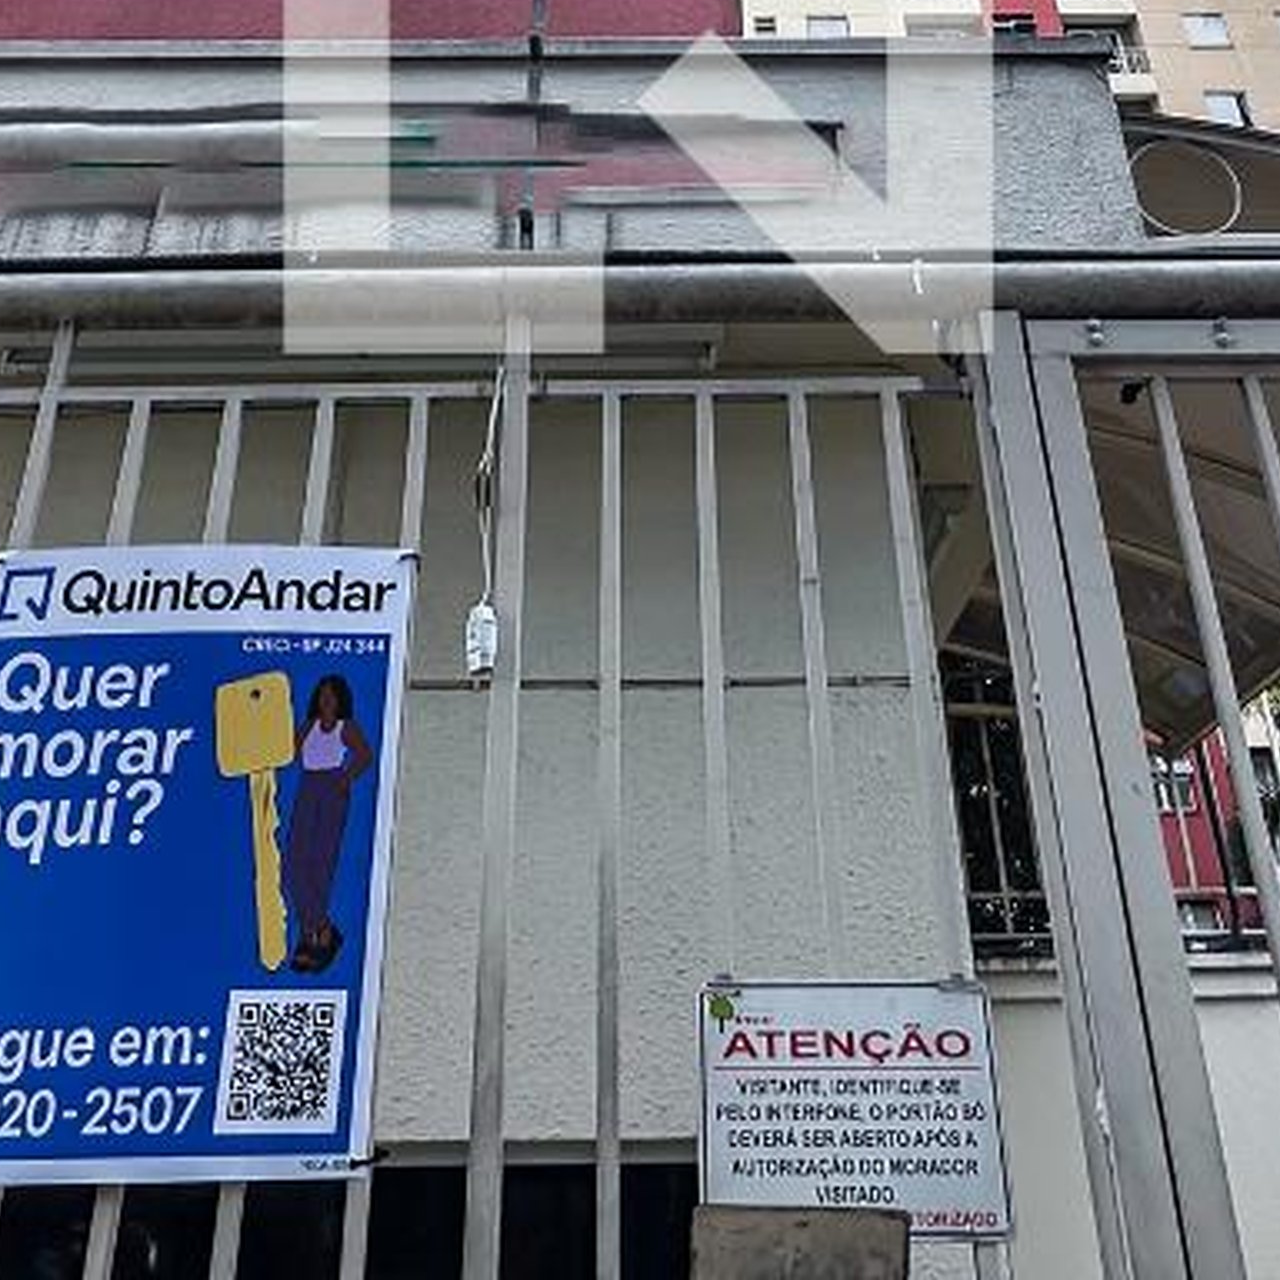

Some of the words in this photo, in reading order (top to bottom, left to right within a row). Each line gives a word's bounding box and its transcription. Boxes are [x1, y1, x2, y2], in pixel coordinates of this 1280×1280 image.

[62, 568, 398, 617] QuintoAndar
[109, 1025, 211, 1068] em:
[722, 1022, 972, 1065] ATENÇÃO
[716, 1103, 761, 1121] PELO
[869, 1103, 884, 1120] O
[886, 1099, 958, 1120] PORTÃO
[727, 1128, 798, 1148] DEVERÁ
[802, 1129, 837, 1148] SER
[839, 1129, 910, 1148] ABERTO
[912, 1128, 961, 1148] APÓS
[963, 1130, 978, 1147] A
[731, 1157, 860, 1179] AUTORIZAÇÃO
[862, 1160, 886, 1176] DO
[888, 1160, 979, 1176] MORADOR
